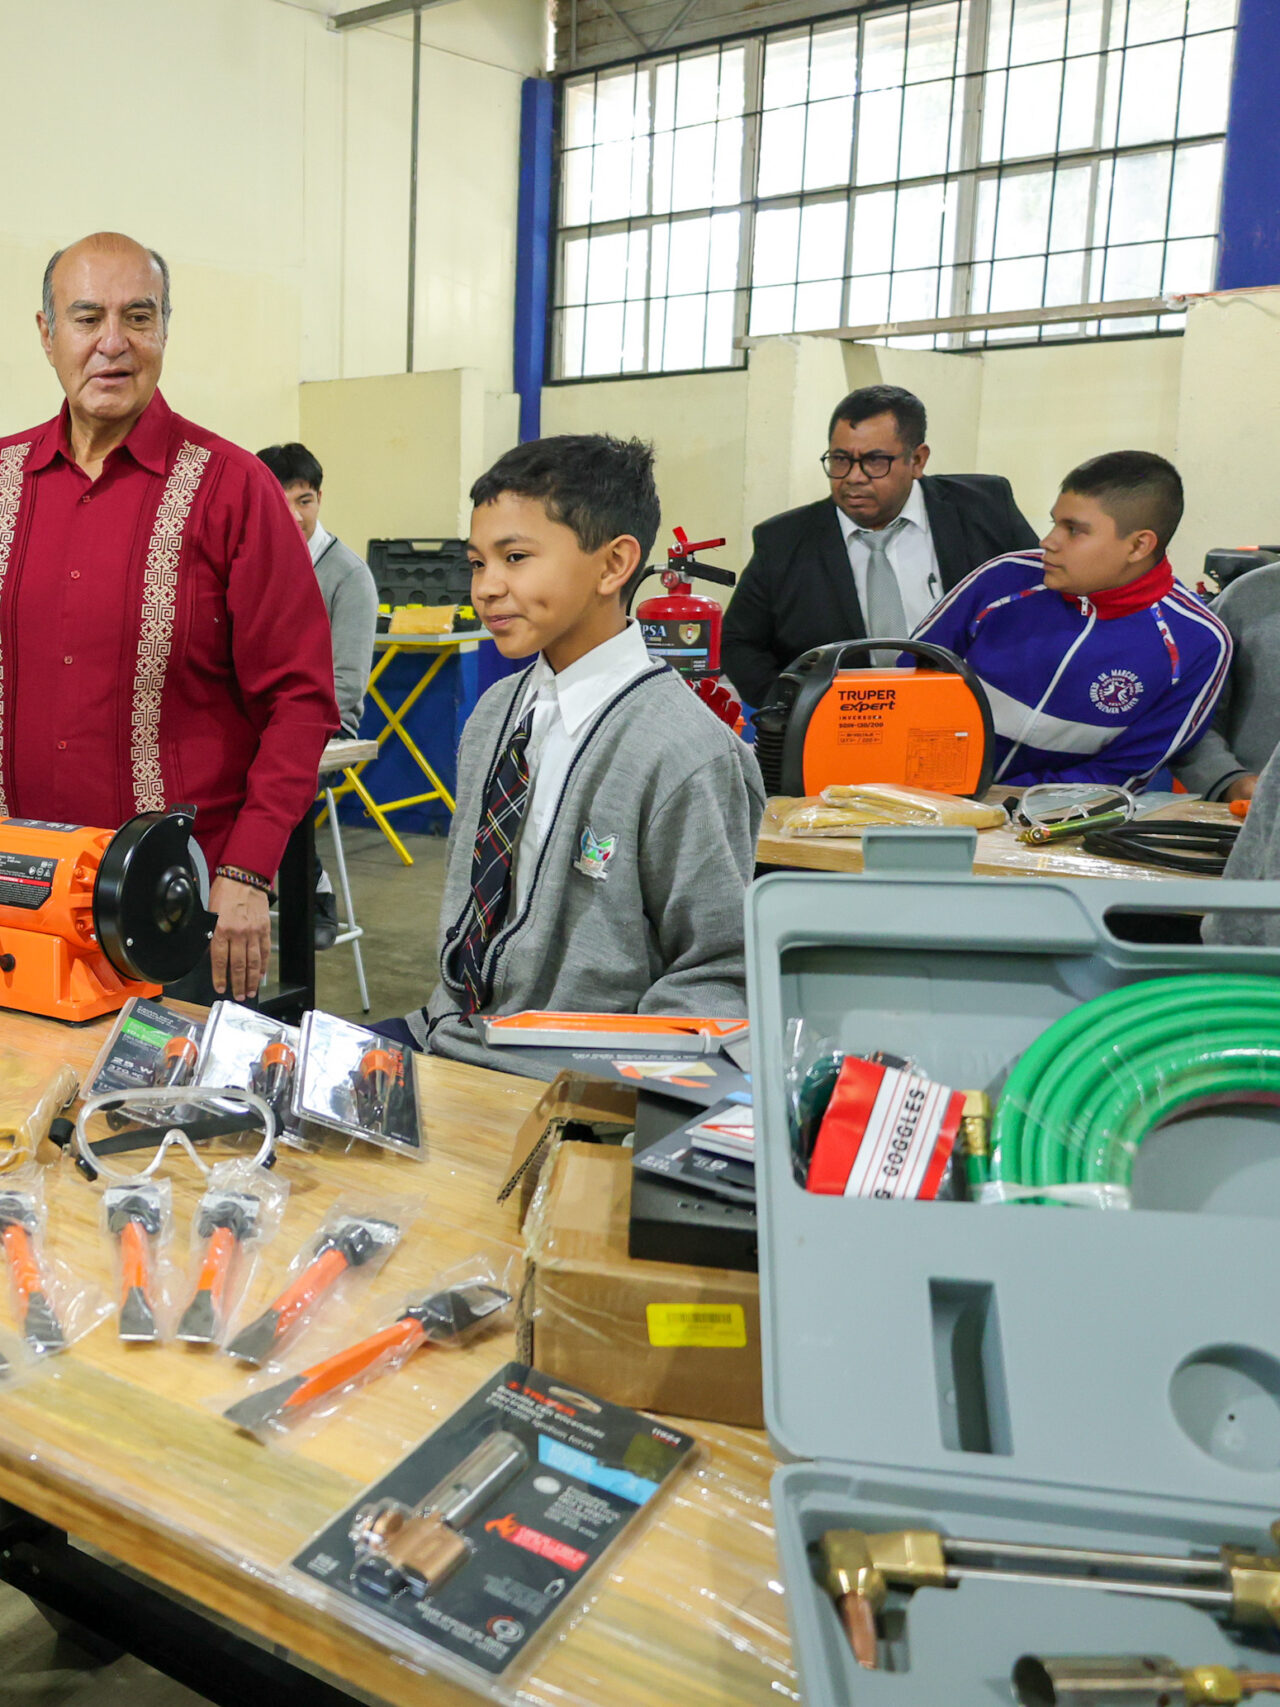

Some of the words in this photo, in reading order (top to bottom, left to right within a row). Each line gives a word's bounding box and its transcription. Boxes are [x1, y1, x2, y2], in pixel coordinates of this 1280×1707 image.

[640, 624, 667, 637] PSA
[838, 690, 896, 700] TRUPER
[840, 701, 896, 712] expert
[883, 1088, 925, 1177] GOGGLES
